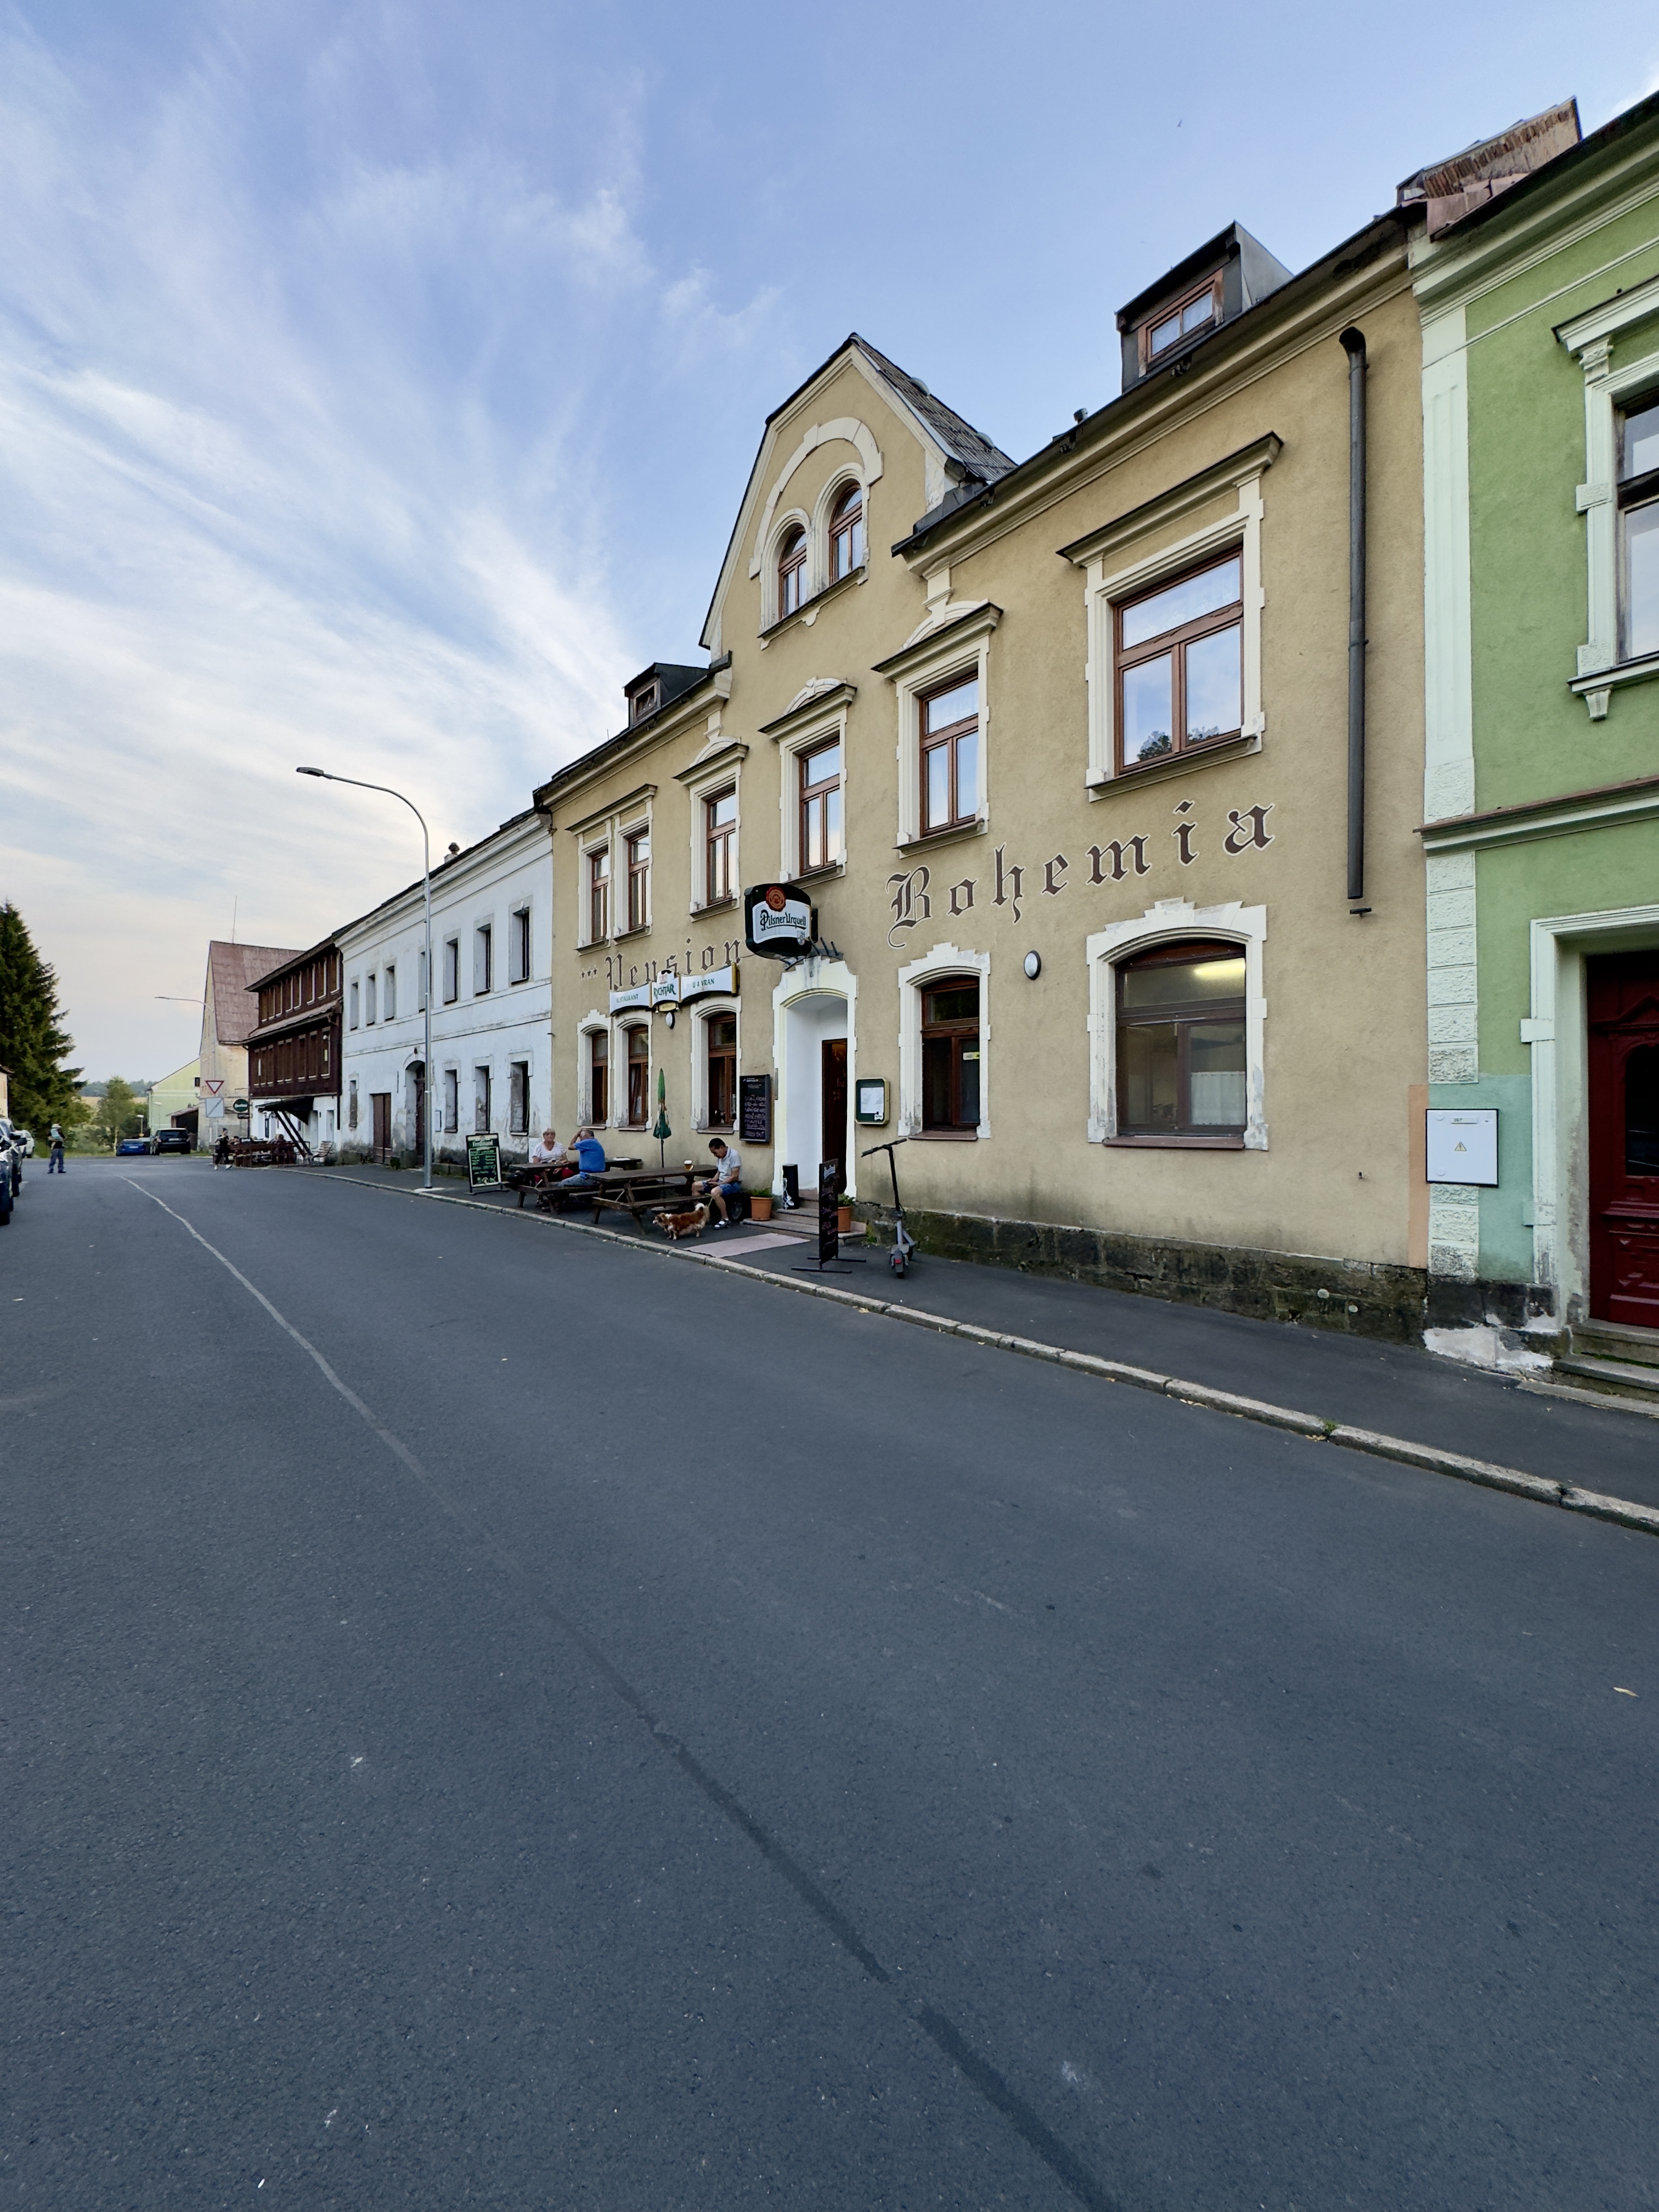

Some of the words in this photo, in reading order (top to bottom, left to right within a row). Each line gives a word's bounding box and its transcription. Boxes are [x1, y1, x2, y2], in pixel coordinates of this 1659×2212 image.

[885, 800, 1275, 949] Bohemia
[759, 910, 786, 932] Pilsner
[785, 911, 806, 929] Urquell
[605, 938, 742, 991] Pension
